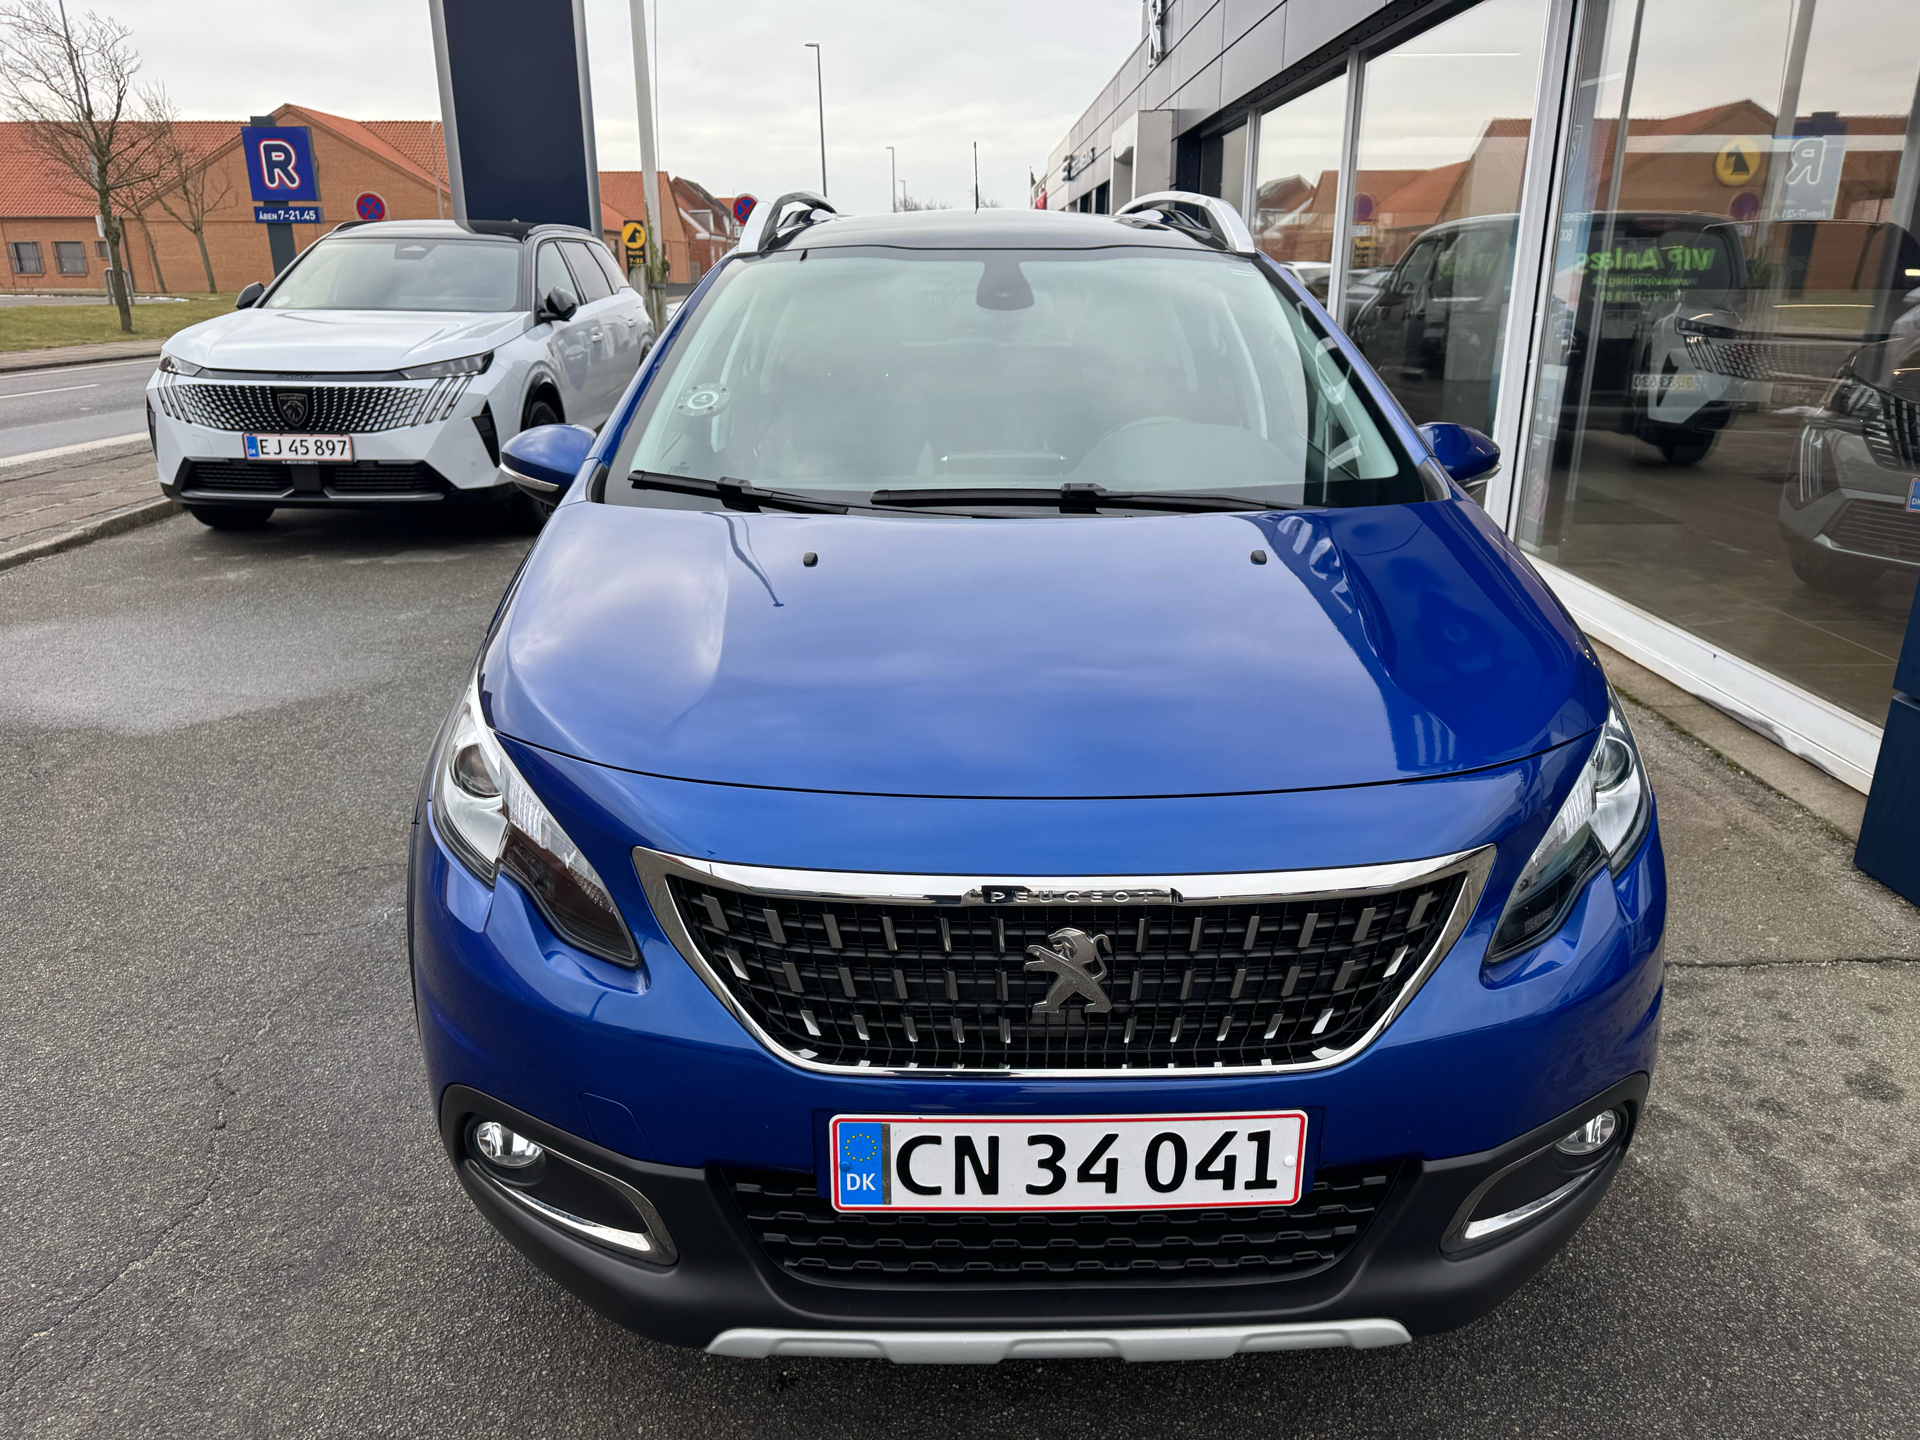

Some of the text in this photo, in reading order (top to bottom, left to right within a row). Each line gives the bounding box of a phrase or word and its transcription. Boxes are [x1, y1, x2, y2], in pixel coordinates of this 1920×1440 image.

[258, 138, 301, 189] R
[258, 210, 316, 221] ÅBEN 7-21.45
[259, 439, 347, 456] EJ 45 897
[991, 890, 1153, 903] PEUGEOT
[896, 1130, 1278, 1196] CN 34 041
[845, 1172, 876, 1192] DK
